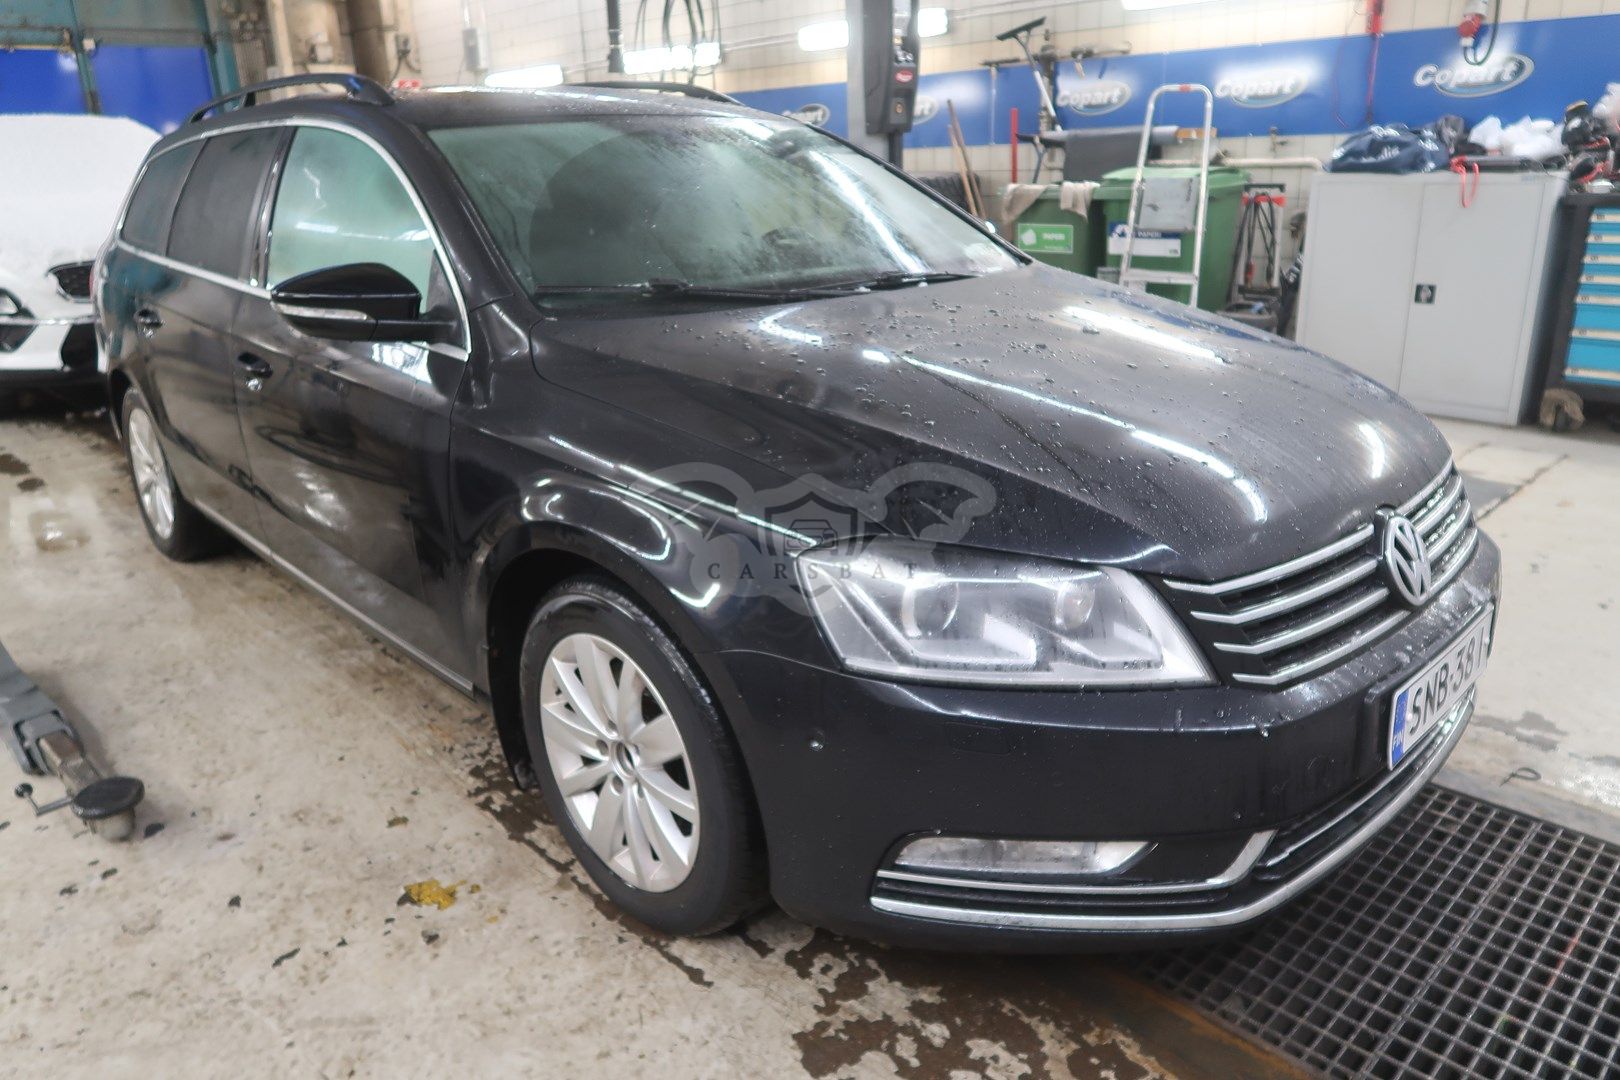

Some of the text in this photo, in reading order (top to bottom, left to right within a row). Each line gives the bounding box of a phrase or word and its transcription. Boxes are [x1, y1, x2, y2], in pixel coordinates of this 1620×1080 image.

[1413, 58, 1519, 89] Copart
[1056, 86, 1121, 109] Copart
[1214, 75, 1297, 101] Copart
[1409, 626, 1486, 735] SNB-381
